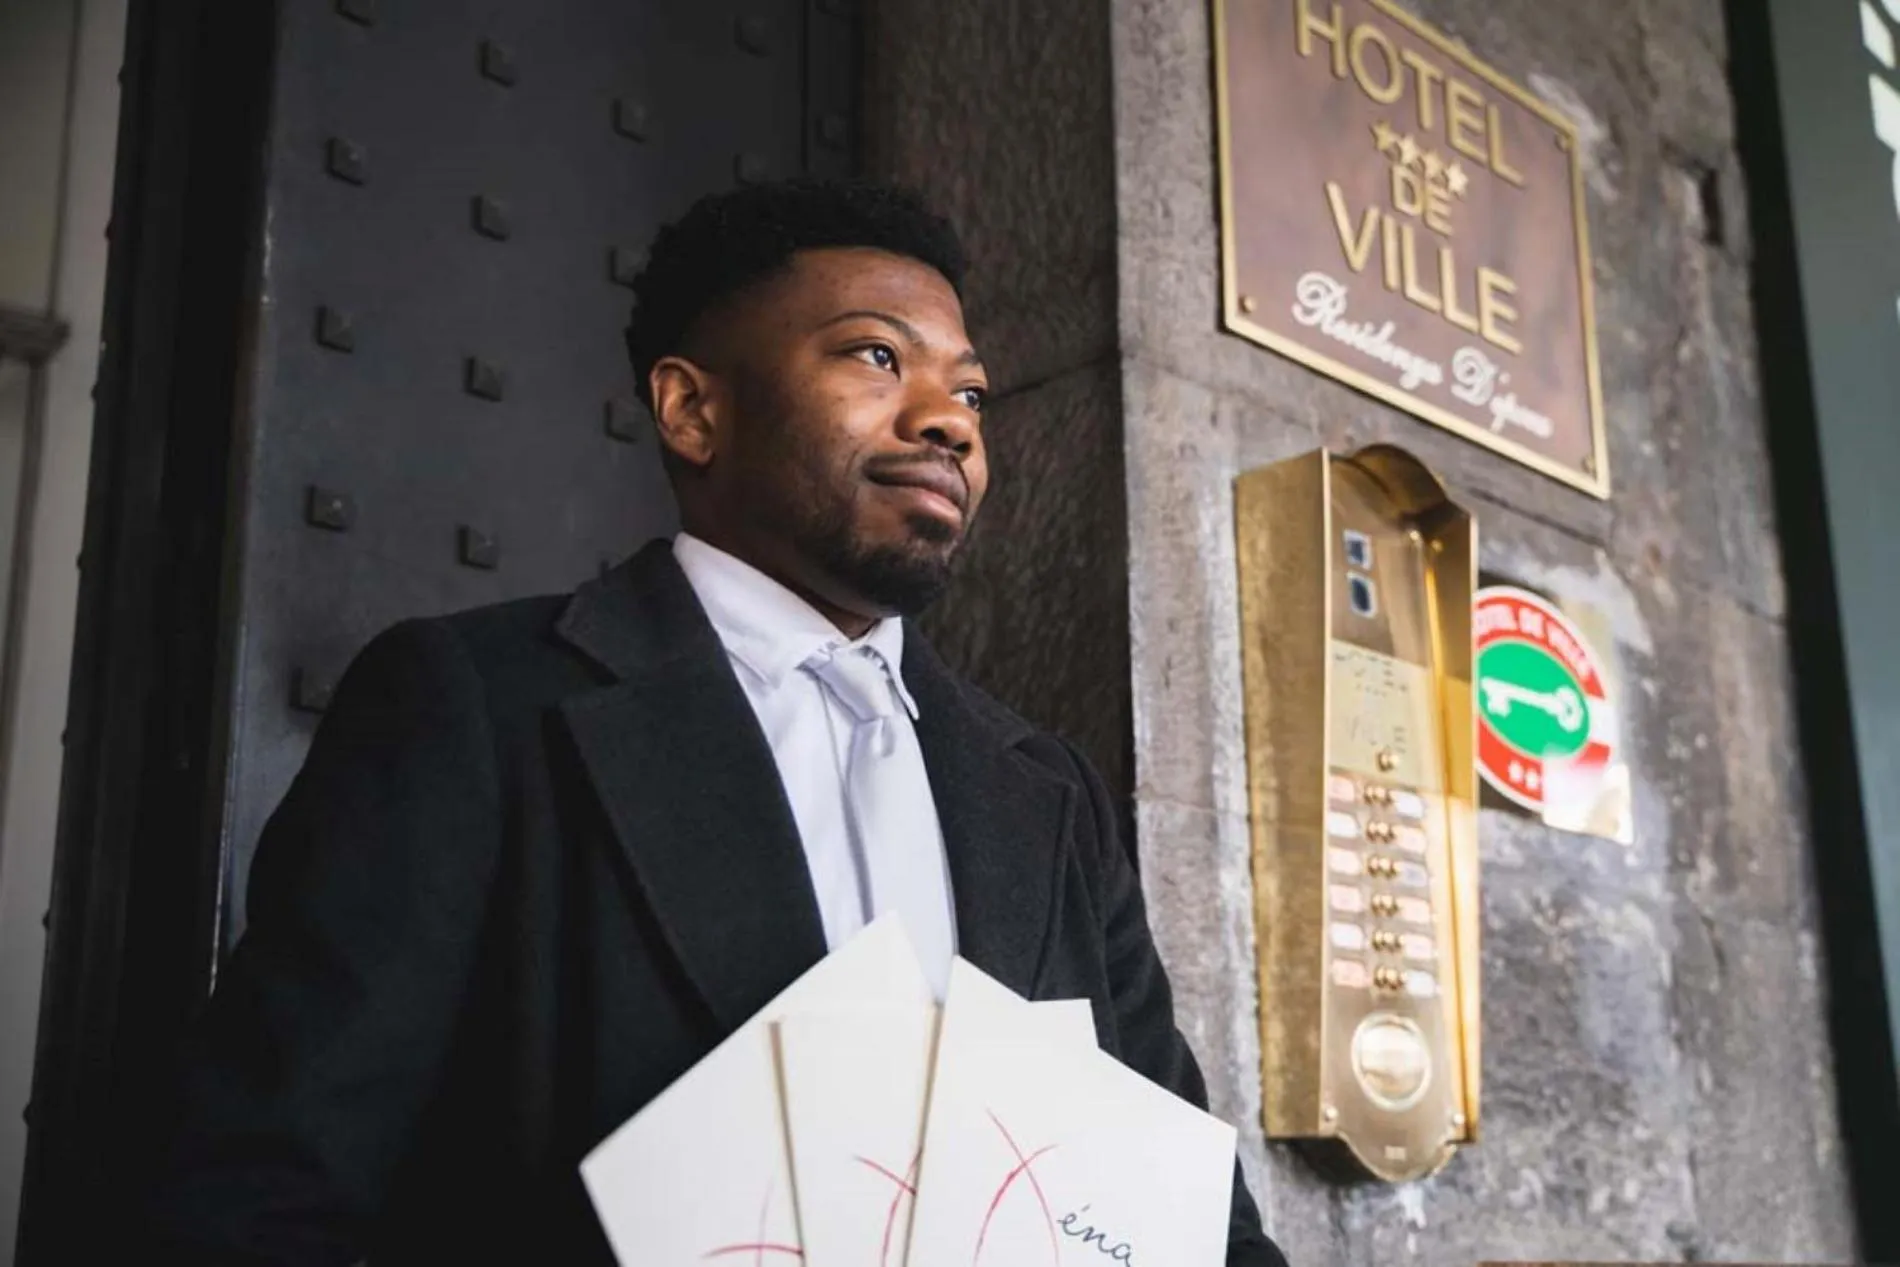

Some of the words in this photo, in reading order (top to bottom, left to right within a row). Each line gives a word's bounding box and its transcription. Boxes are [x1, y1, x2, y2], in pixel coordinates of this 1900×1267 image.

[1295, 0, 1525, 188] HOTEL
[1325, 180, 1524, 355] VILLE
[1390, 163, 1454, 238] DE
